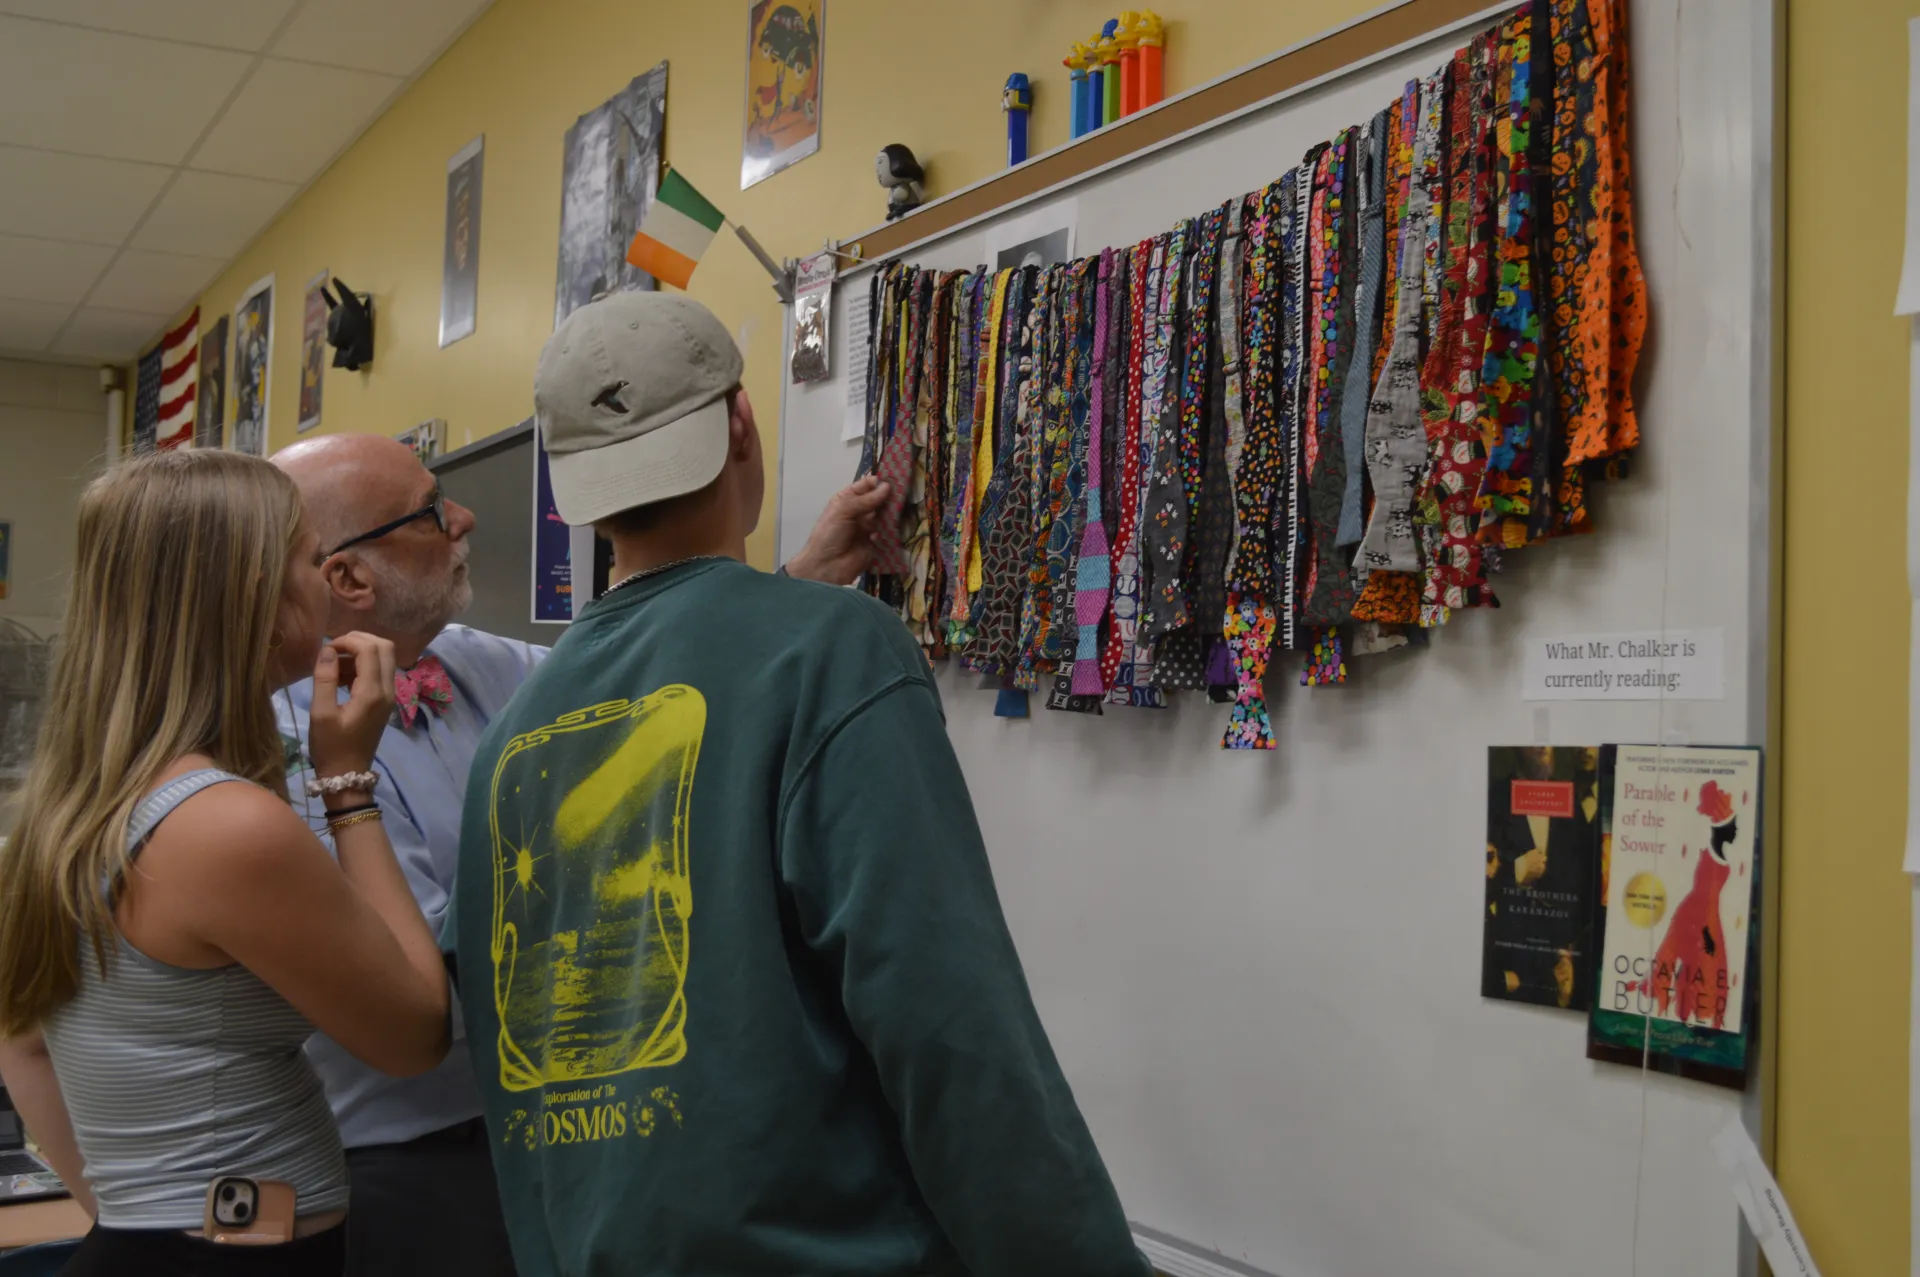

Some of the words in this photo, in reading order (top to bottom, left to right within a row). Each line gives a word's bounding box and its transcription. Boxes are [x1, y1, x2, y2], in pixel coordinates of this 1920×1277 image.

[1545, 642, 1584, 660] What
[1588, 642, 1614, 659] Mr.
[1618, 639, 1678, 658] Chalker
[1683, 639, 1696, 657] is
[1545, 670, 1612, 692] currently
[1616, 669, 1681, 692] reading:
[1623, 782, 1676, 802] Parable
[1621, 808, 1640, 826] of
[1642, 809, 1665, 828] the
[1620, 835, 1666, 855] Sower
[544, 1089, 590, 1107] xploration
[592, 1085, 604, 1099] of
[604, 1084, 617, 1097] The
[543, 1101, 627, 1145] OSMOS
